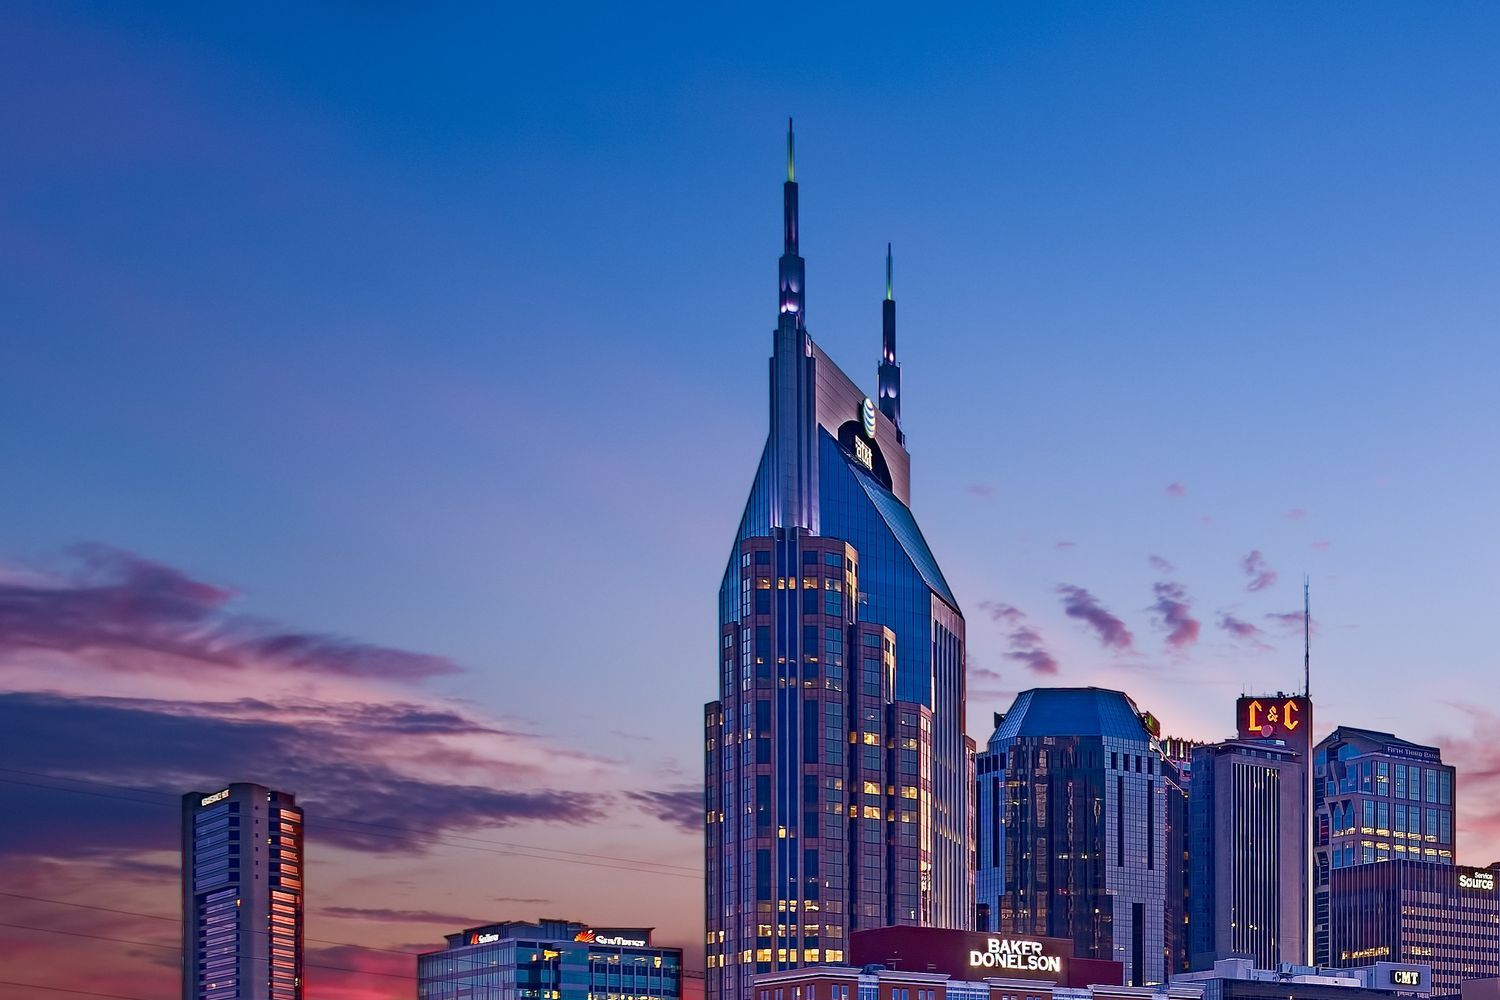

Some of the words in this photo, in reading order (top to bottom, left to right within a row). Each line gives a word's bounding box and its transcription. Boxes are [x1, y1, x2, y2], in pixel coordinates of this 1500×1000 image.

[1248, 700, 1262, 731] L
[1267, 705, 1278, 722] &
[1284, 700, 1299, 731] C
[1387, 746, 1404, 754] FIFTH
[1405, 748, 1423, 757] THIRD
[1459, 874, 1494, 890] Source
[1474, 871, 1493, 880] Service
[987, 938, 1043, 956] BAKER
[969, 950, 1061, 973] DONELSON
[1394, 971, 1419, 985] CMT
